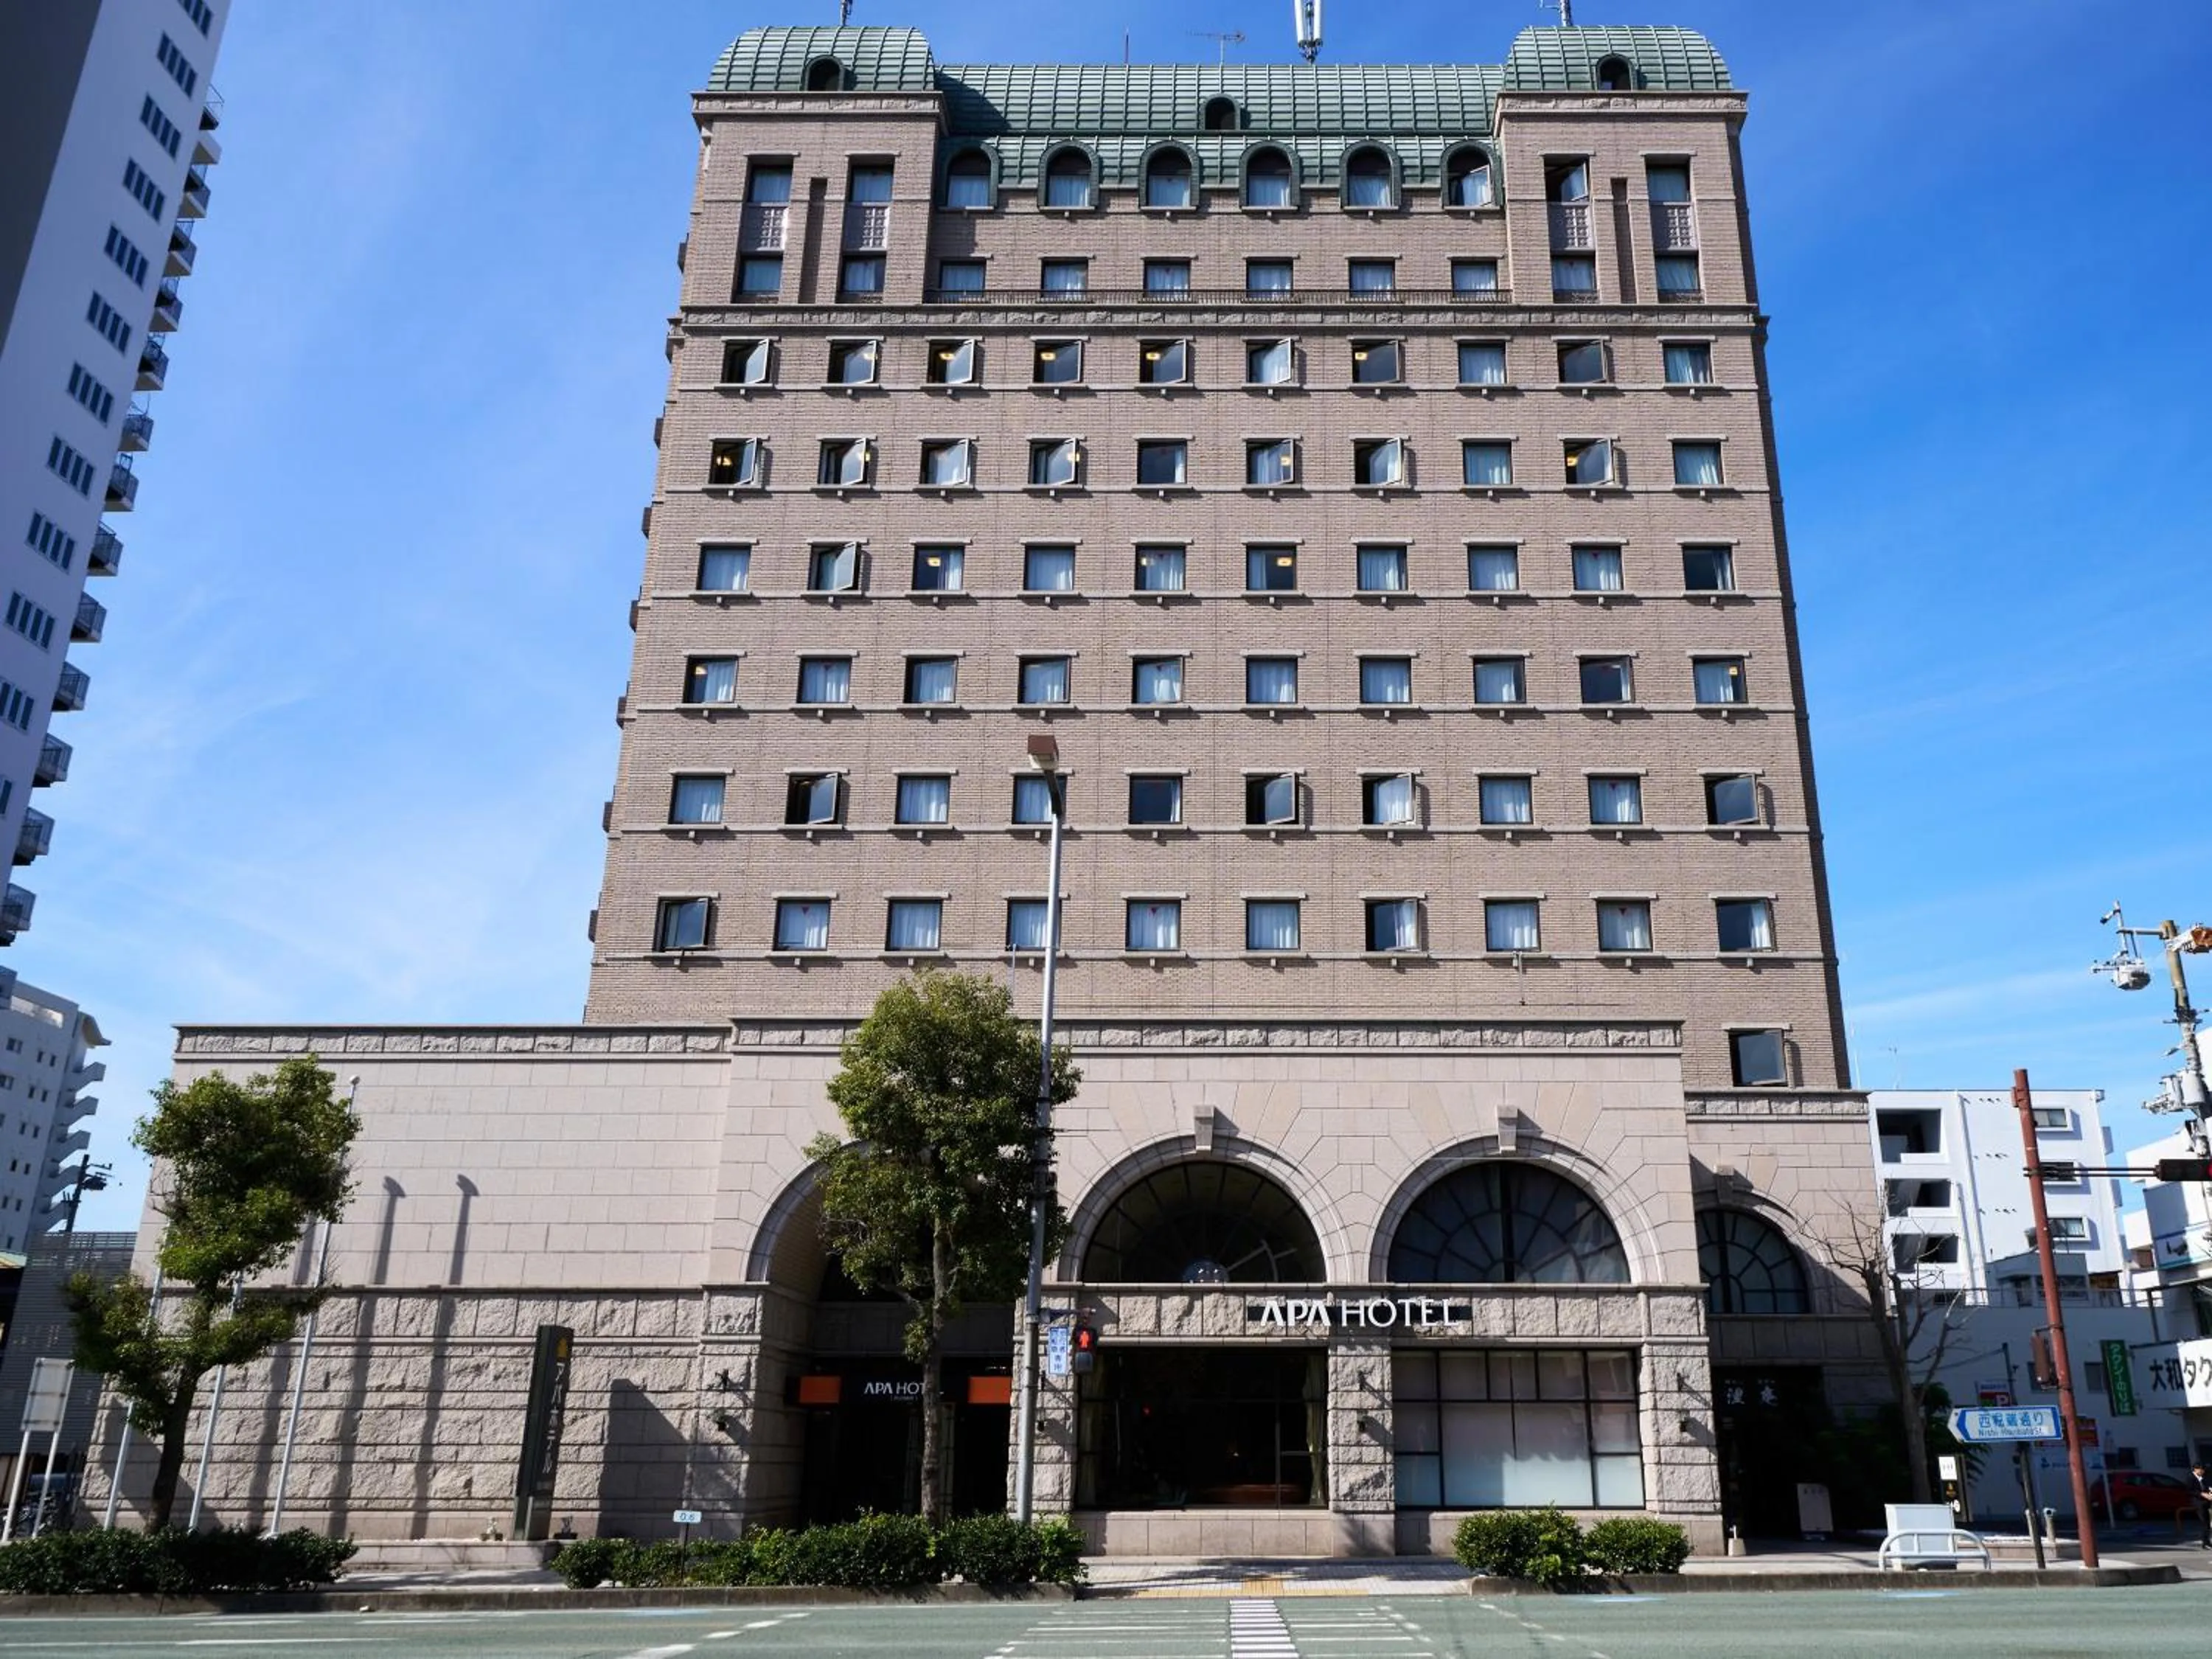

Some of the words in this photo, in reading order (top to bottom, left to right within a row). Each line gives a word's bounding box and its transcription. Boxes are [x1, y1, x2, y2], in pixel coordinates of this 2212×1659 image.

[1260, 1299, 1331, 1326] APA
[1341, 1298, 1458, 1327] HOTEL
[863, 1382, 893, 1395] APA
[897, 1382, 944, 1395] HOT
[542, 1363, 566, 1475] アパホテル
